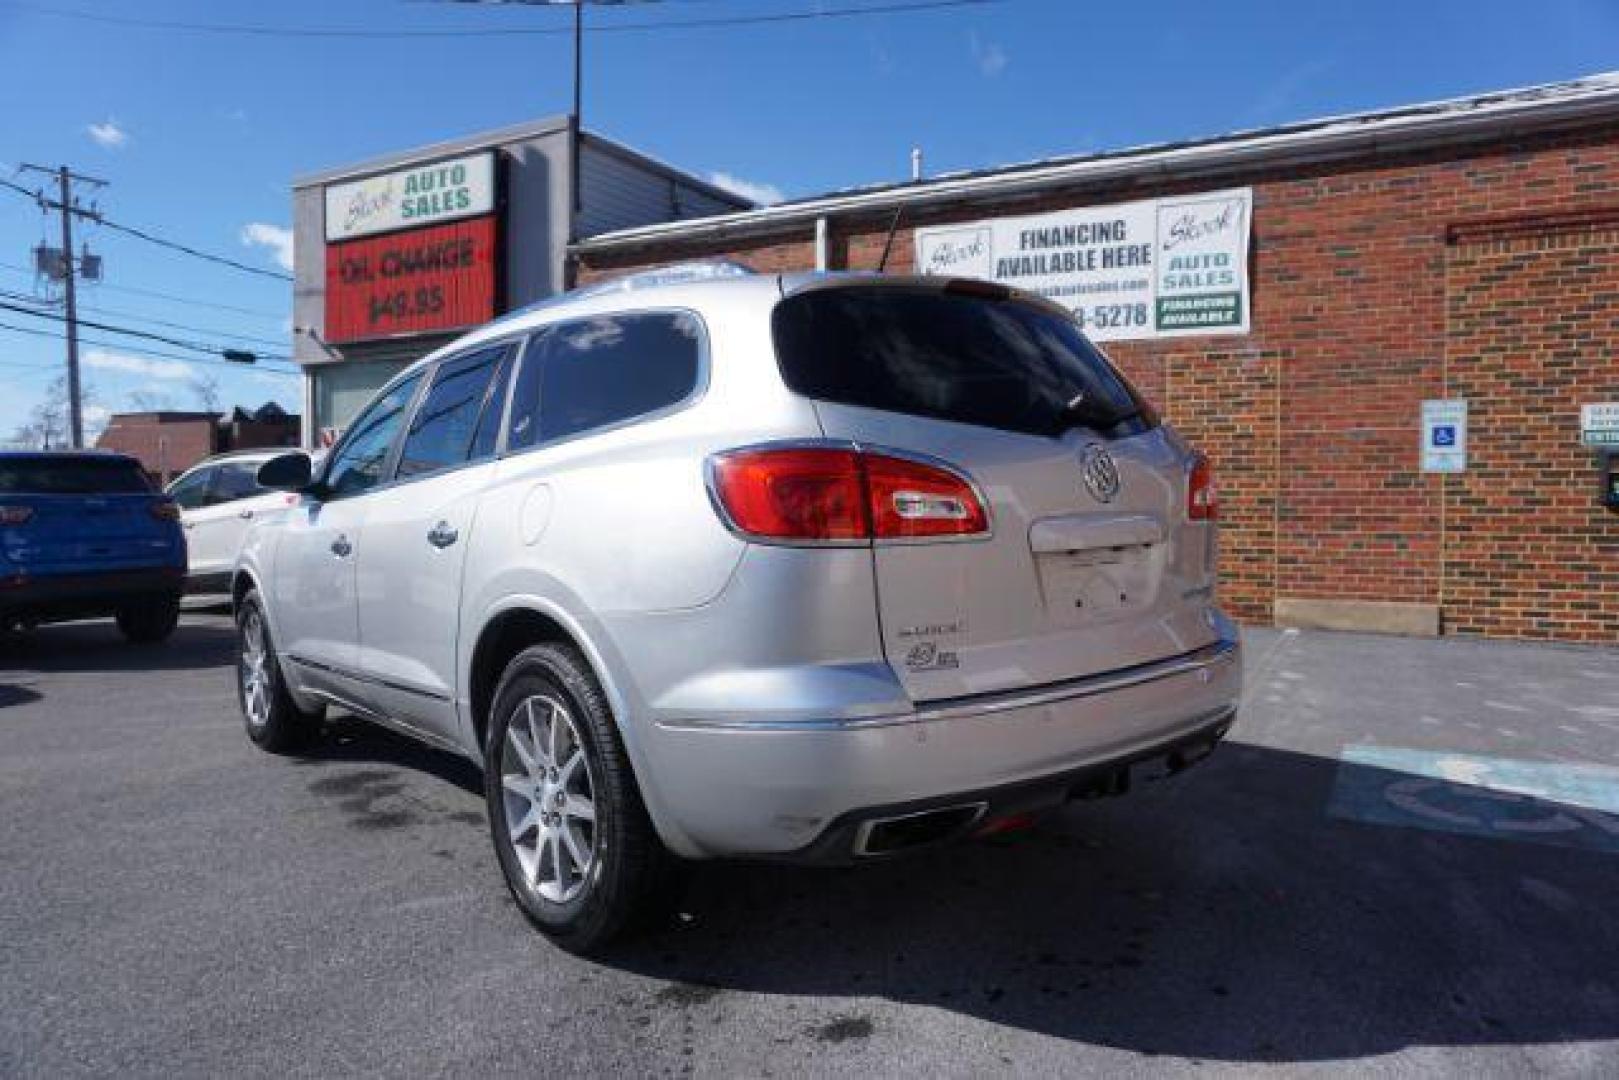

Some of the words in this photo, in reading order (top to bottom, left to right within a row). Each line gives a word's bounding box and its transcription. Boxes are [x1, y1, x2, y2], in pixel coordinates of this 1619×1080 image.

[404, 163, 466, 195] AUTO
[401, 187, 471, 218] SALES
[1020, 219, 1127, 251] FINANCING
[340, 254, 376, 284] OIL
[380, 237, 474, 278] CHANGE
[996, 249, 1097, 279] AVAILABLE
[1102, 243, 1152, 269] HERE
[1168, 253, 1231, 271] AUTO
[1163, 271, 1234, 289] SALES
